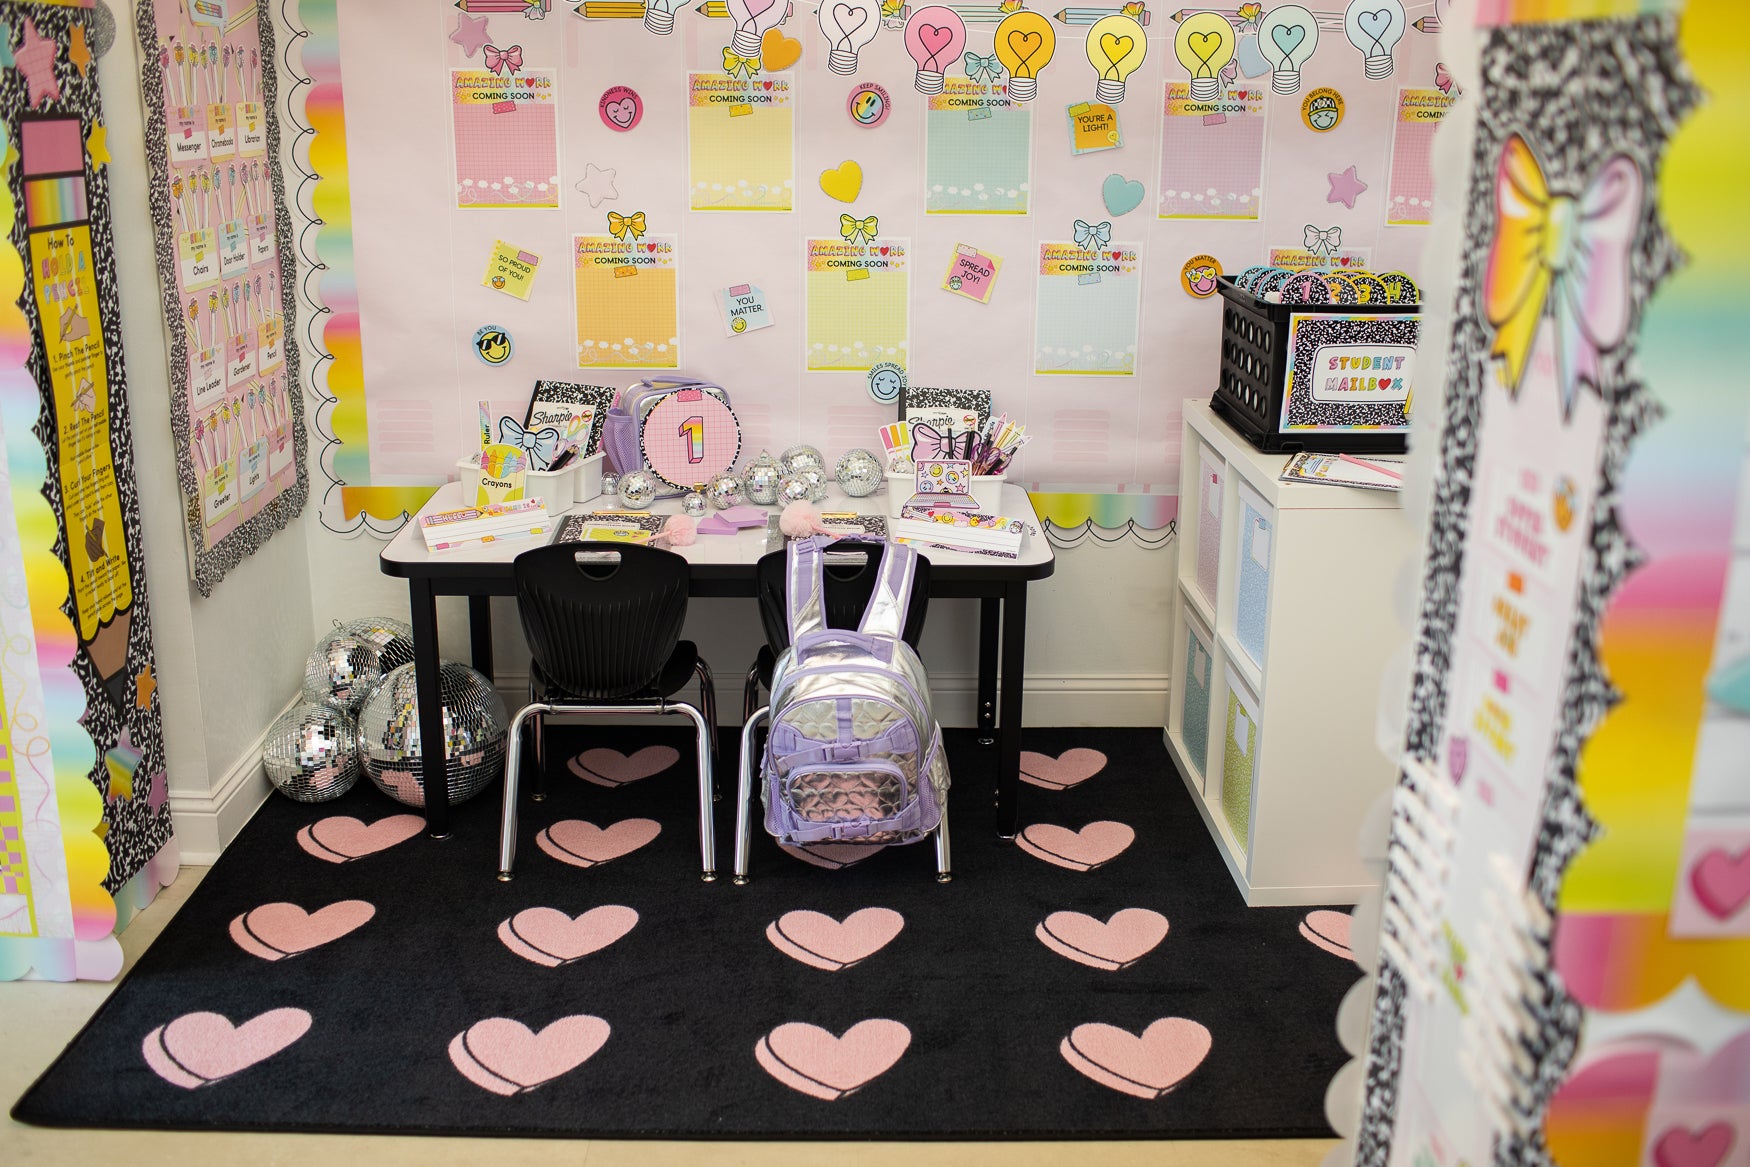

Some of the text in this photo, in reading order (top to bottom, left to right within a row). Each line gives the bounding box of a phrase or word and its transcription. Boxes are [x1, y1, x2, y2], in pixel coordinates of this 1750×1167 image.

[454, 77, 511, 89] AMAZING
[692, 80, 748, 92] AMAZING
[859, 84, 873, 92] KEEP
[472, 92, 535, 100] COMING SOON
[600, 86, 638, 108] KINDNESS WINS
[709, 95, 772, 103] COMING SOON
[1301, 88, 1344, 111] YOU BELONG HERE
[948, 98, 1011, 107] COMING SOON
[1184, 104, 1246, 113] COMING SOON
[1077, 113, 1113, 123] YOU'RE A
[1083, 123, 1109, 132] LIGHT!
[176, 142, 202, 153] Messenger
[48, 234, 75, 250] How To
[577, 241, 633, 254] AMAZING
[810, 245, 866, 257] AMAZING
[1043, 249, 1098, 261] AMAZING
[498, 254, 531, 273] SO PROUD
[594, 256, 656, 264] COMING SOON
[826, 259, 889, 268] COMING SOON
[1184, 255, 1217, 271] YOU MATTER
[1272, 255, 1327, 267] AMAZING
[193, 265, 208, 275] Chairs
[960, 259, 990, 277] SPREAD
[1059, 264, 1120, 272] COMING SOON
[509, 270, 524, 281] YOU!
[961, 271, 981, 284] JOY!
[1300, 282, 1312, 301] 1
[1330, 283, 1342, 302] 2
[1360, 284, 1371, 302] 3
[1388, 282, 1401, 301] 4
[736, 296, 754, 305] YOU
[484, 325, 497, 333] YOU
[1328, 356, 1405, 370] STUDENT
[868, 364, 883, 380] SMILES
[884, 362, 904, 375] SPREAD
[197, 379, 221, 396] Line Leader
[530, 410, 572, 426] Sharpie
[678, 416, 704, 464] 1
[482, 477, 512, 488] Crayons
[214, 493, 231, 509] Greeter
